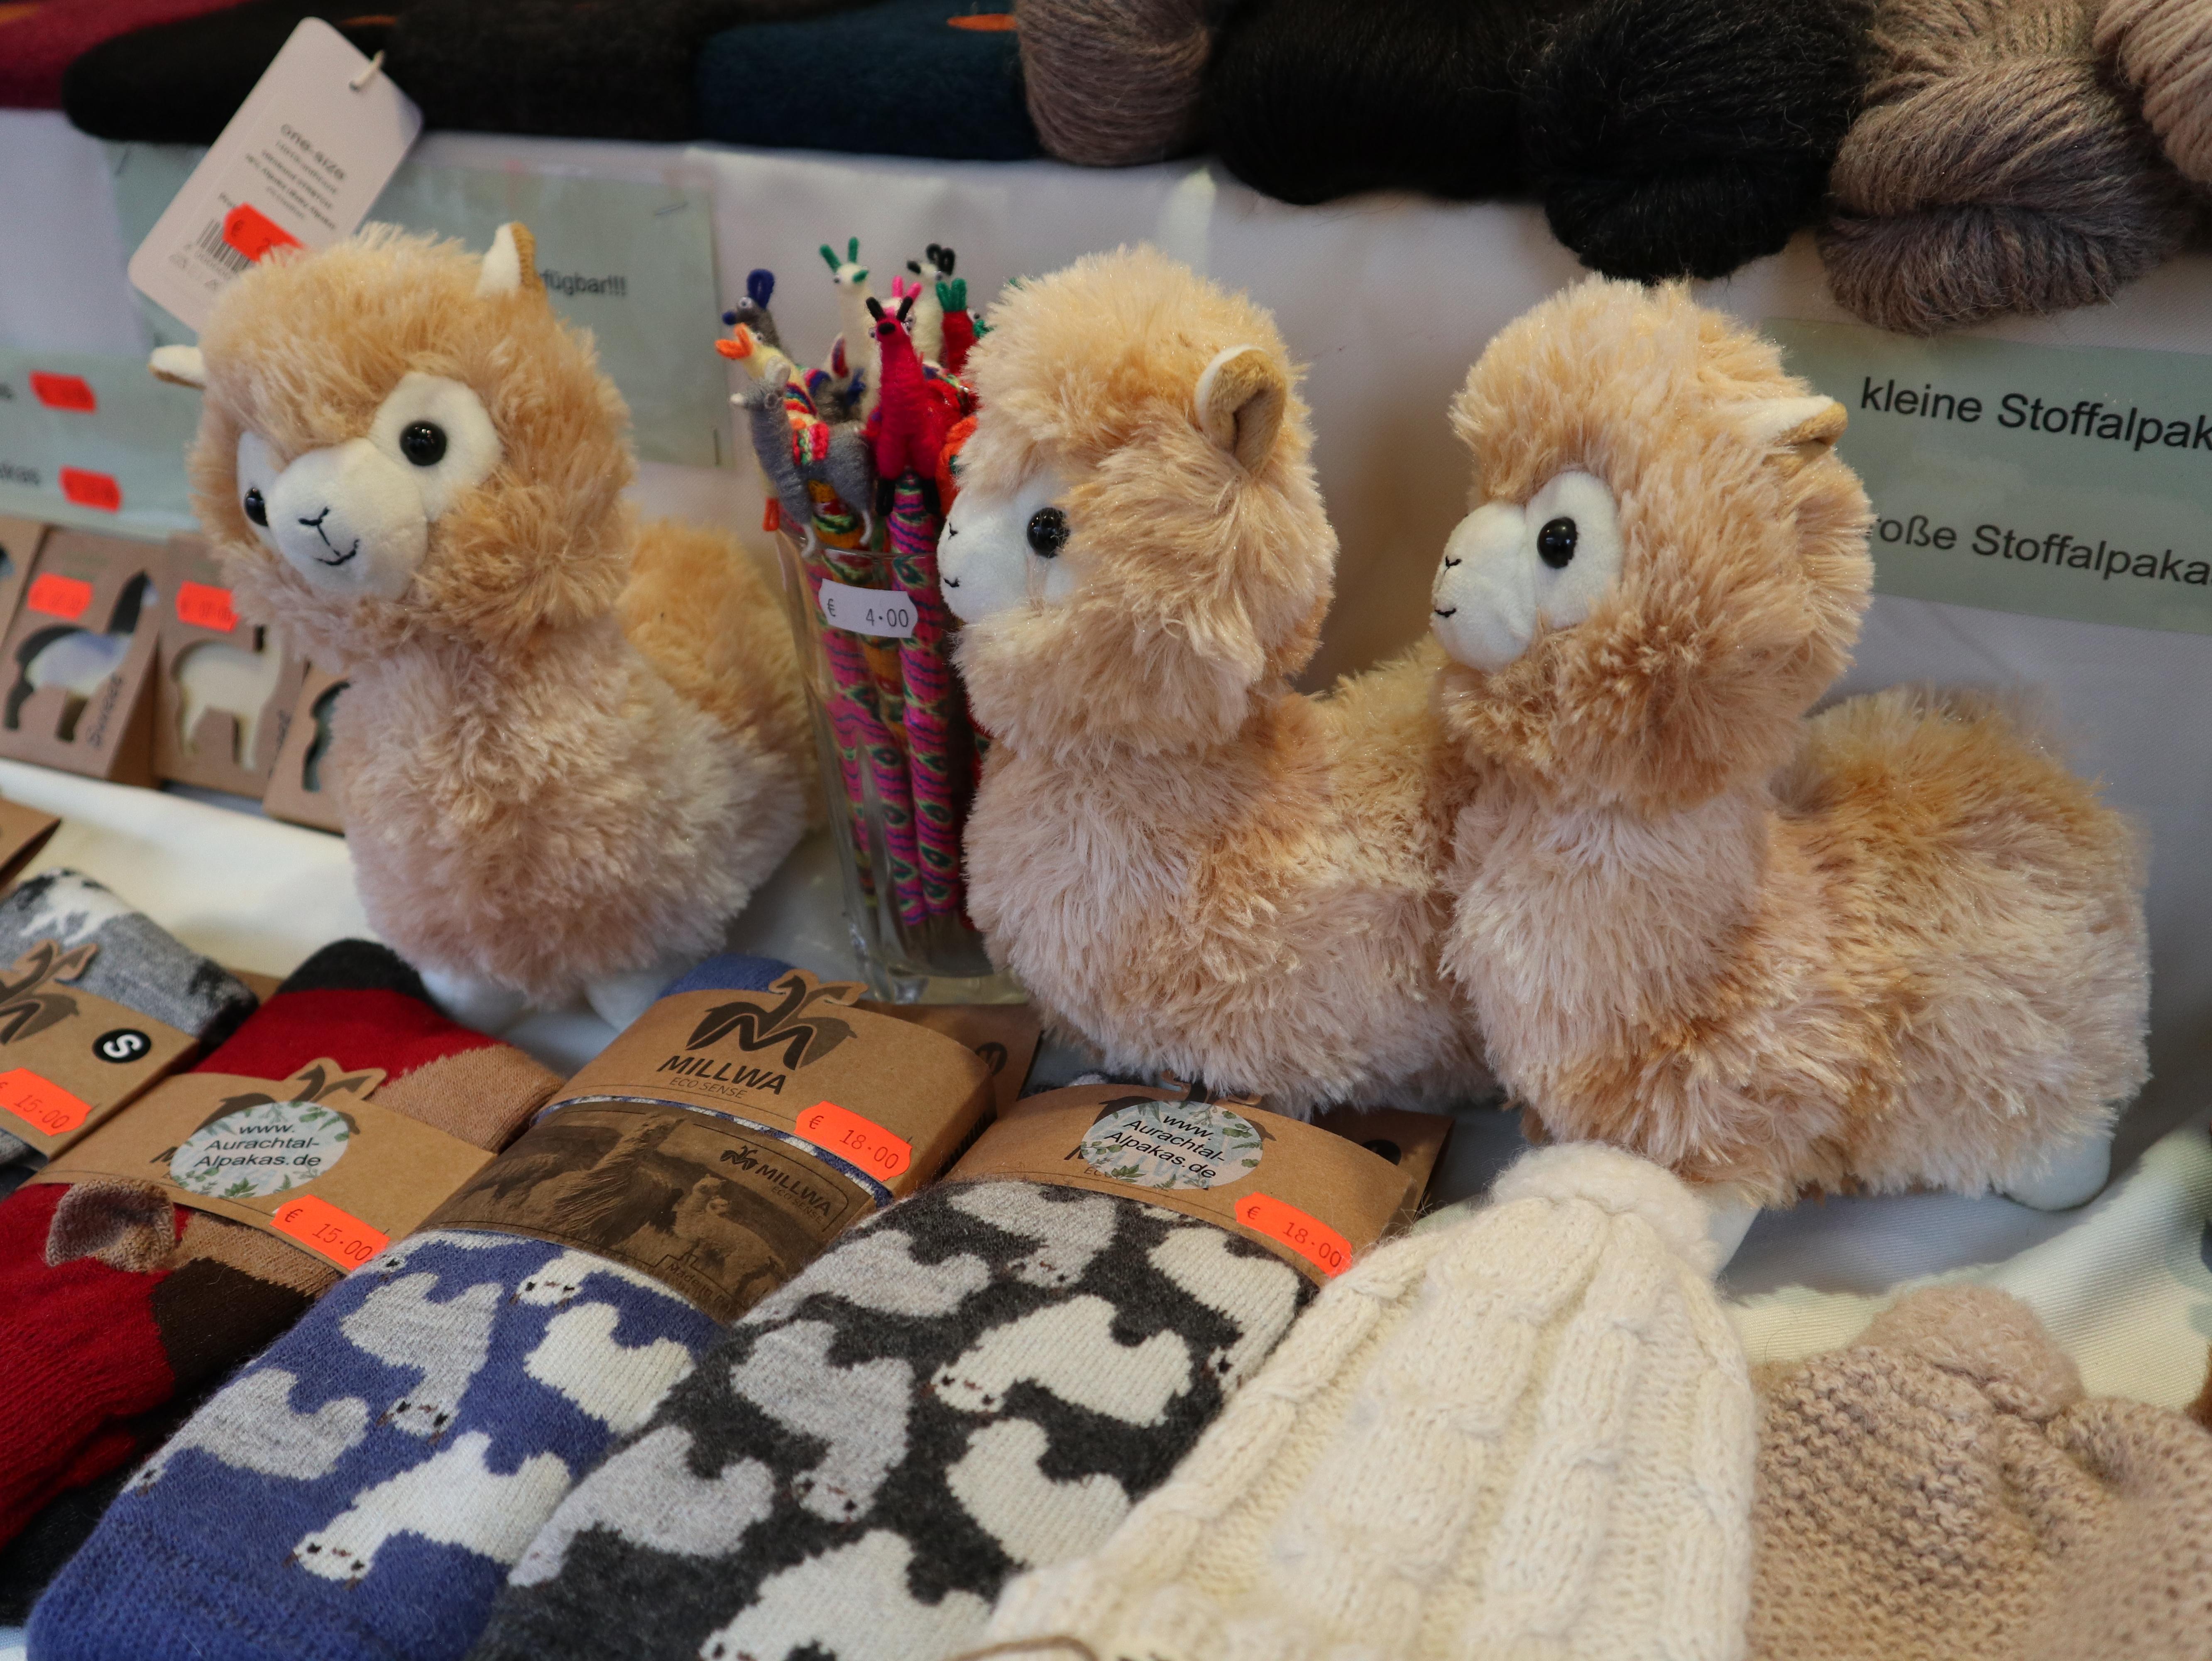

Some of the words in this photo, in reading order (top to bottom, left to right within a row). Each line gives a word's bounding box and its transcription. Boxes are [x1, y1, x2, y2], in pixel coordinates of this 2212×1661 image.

[541, 269, 627, 296] fügbar!!!
[1860, 376, 1982, 423] kleine
[1997, 393, 2212, 451] Stoffalpak
[1874, 514, 1958, 549] oße
[1972, 524, 2212, 586] Stoffalpaka
[827, 598, 836, 617] €
[103, 1034, 143, 1058] S
[656, 1055, 786, 1095] MILLWA
[669, 1077, 699, 1088] ECO
[699, 1082, 748, 1099] SENSE
[239, 1124, 295, 1134] www.
[810, 1115, 824, 1129] €
[1162, 1115, 1214, 1140] www.
[204, 1137, 320, 1151] Aurachtal-
[1123, 1120, 1225, 1161] Aurachtal-
[193, 1154, 321, 1169] Alpakas.de
[1104, 1132, 1216, 1178] Alpakas.de
[755, 1164, 831, 1216] MILLWA
[284, 1208, 303, 1222] €
[771, 1186, 792, 1200] ECO
[792, 1198, 824, 1224] SENSE
[1247, 1206, 1260, 1220] €
[665, 1263, 700, 1286] Made
